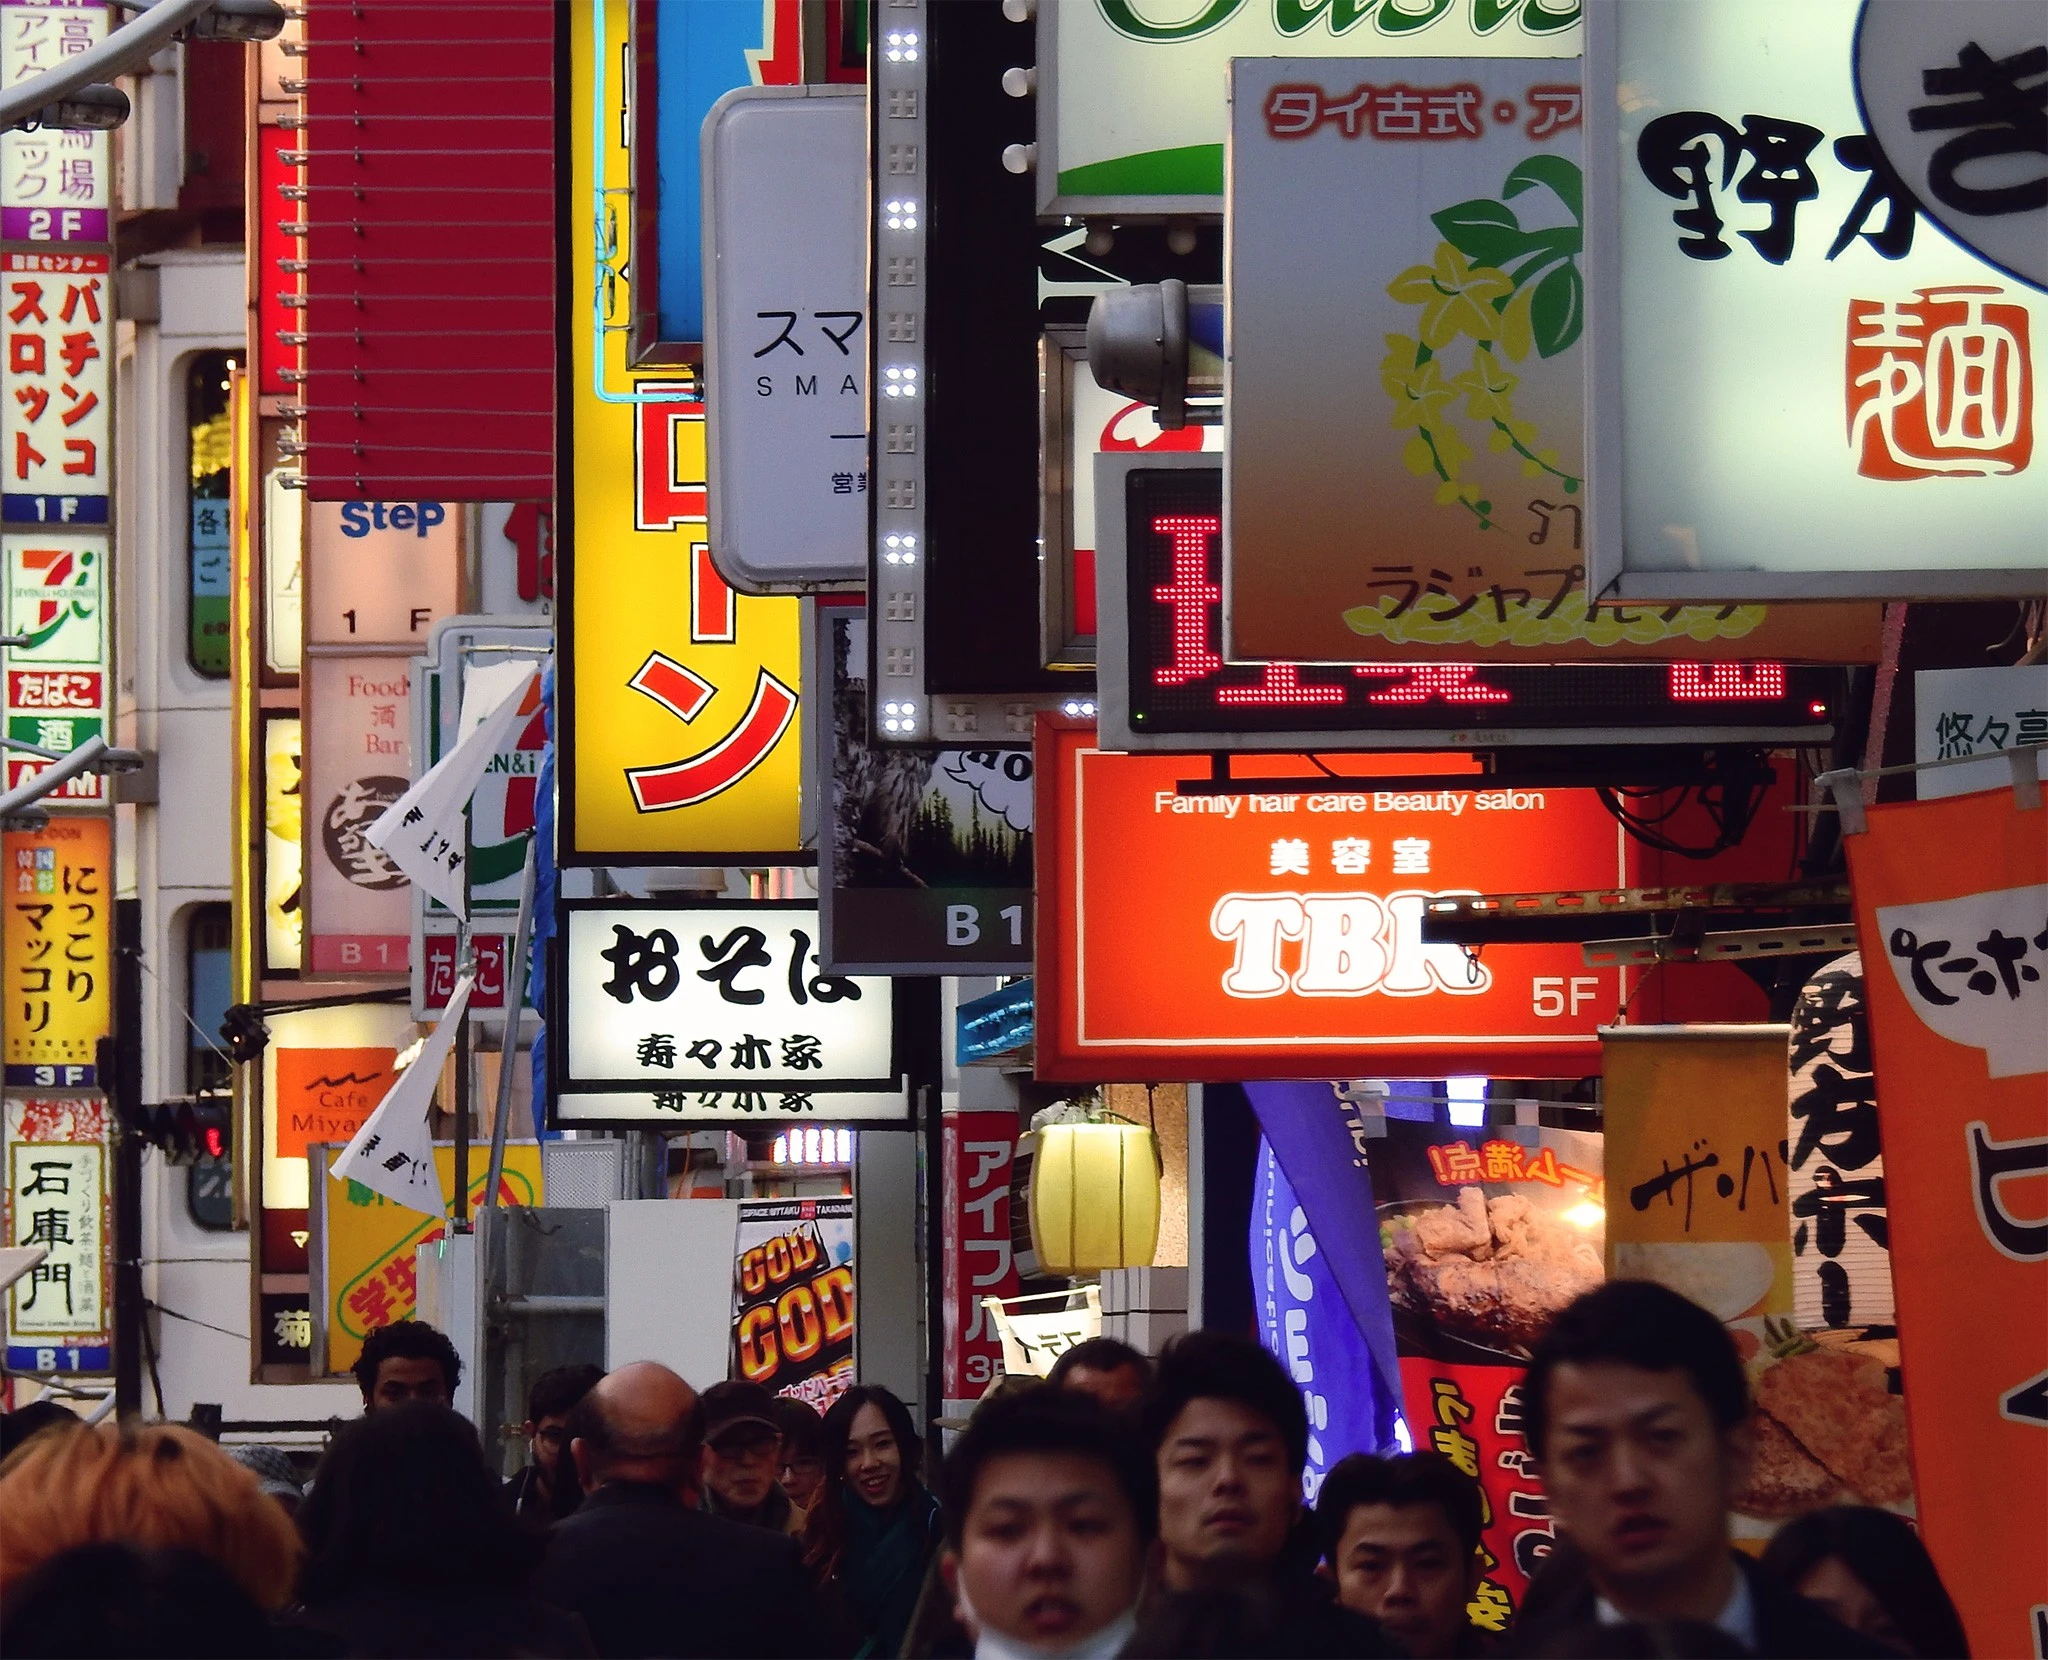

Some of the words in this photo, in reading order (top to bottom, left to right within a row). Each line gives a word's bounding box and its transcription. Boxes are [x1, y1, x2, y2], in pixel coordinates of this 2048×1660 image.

[60, 16, 94, 199] 高馬場
[29, 210, 82, 240] 2F
[754, 311, 863, 358] スマ
[8, 281, 49, 480] スロット
[59, 278, 101, 475] パチンコ
[36, 498, 79, 522] 1F
[340, 501, 446, 538] Step
[1366, 564, 1738, 623] ラジャプ
[343, 609, 432, 635] 1F
[18, 674, 93, 706] たばこ
[349, 675, 409, 698] Food
[37, 719, 74, 750] 酒
[366, 734, 404, 755] Bar
[17, 764, 97, 796] AM
[1155, 791, 1237, 818] Family
[1249, 792, 1300, 813] hair
[1307, 794, 1367, 813] care
[1373, 791, 1467, 817] Beauty
[1475, 789, 1545, 812] salon
[1270, 837, 1431, 876] 美容室
[63, 866, 98, 1002] にっこり
[946, 904, 1022, 946] B1
[16, 903, 54, 1032] マッコリ
[341, 943, 389, 966] B1
[430, 948, 500, 996] たこ
[1531, 977, 1598, 1017] 5F
[34, 1065, 84, 1086] 3F
[319, 1091, 369, 1108] Cafe
[292, 1114, 366, 1136] Miya
[20, 1161, 74, 1315] 石庫門
[964, 1141, 1011, 1342] アイフル
[738, 1223, 819, 1295] GOD
[36, 1349, 80, 1372] B1
